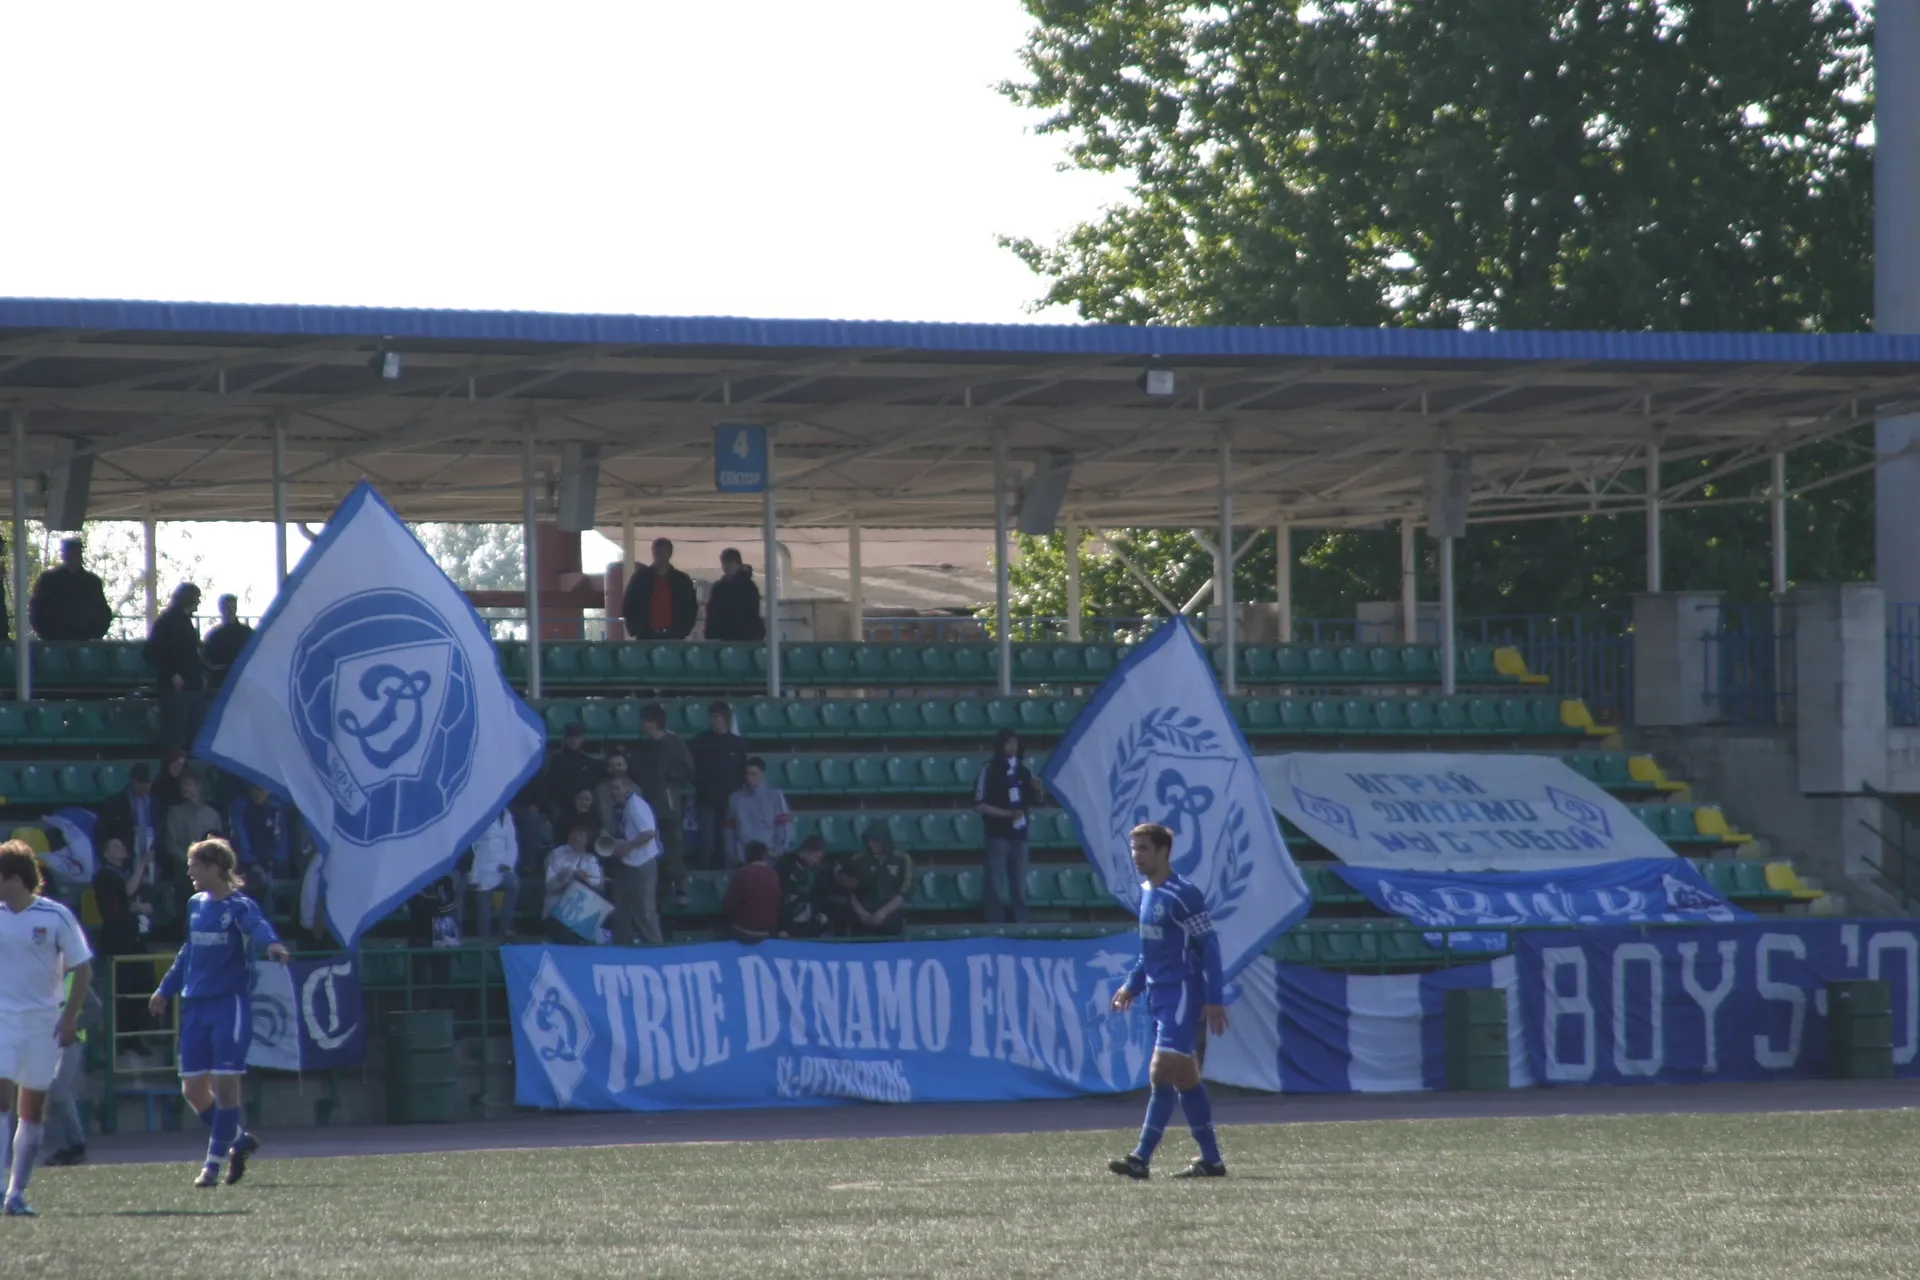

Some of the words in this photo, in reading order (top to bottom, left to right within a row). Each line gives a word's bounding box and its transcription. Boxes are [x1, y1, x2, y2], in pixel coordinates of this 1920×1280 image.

[732, 430, 749, 459] 4
[1344, 770, 1488, 795] ИГРАЙ
[1370, 799, 1539, 823] ДИНАМО
[1468, 825, 1607, 851] ТОБОЙ
[1542, 932, 1806, 1081] BOYS
[592, 961, 730, 1094] TRUE
[737, 954, 951, 1053] DYNAMO
[966, 953, 1084, 1083] FANS
